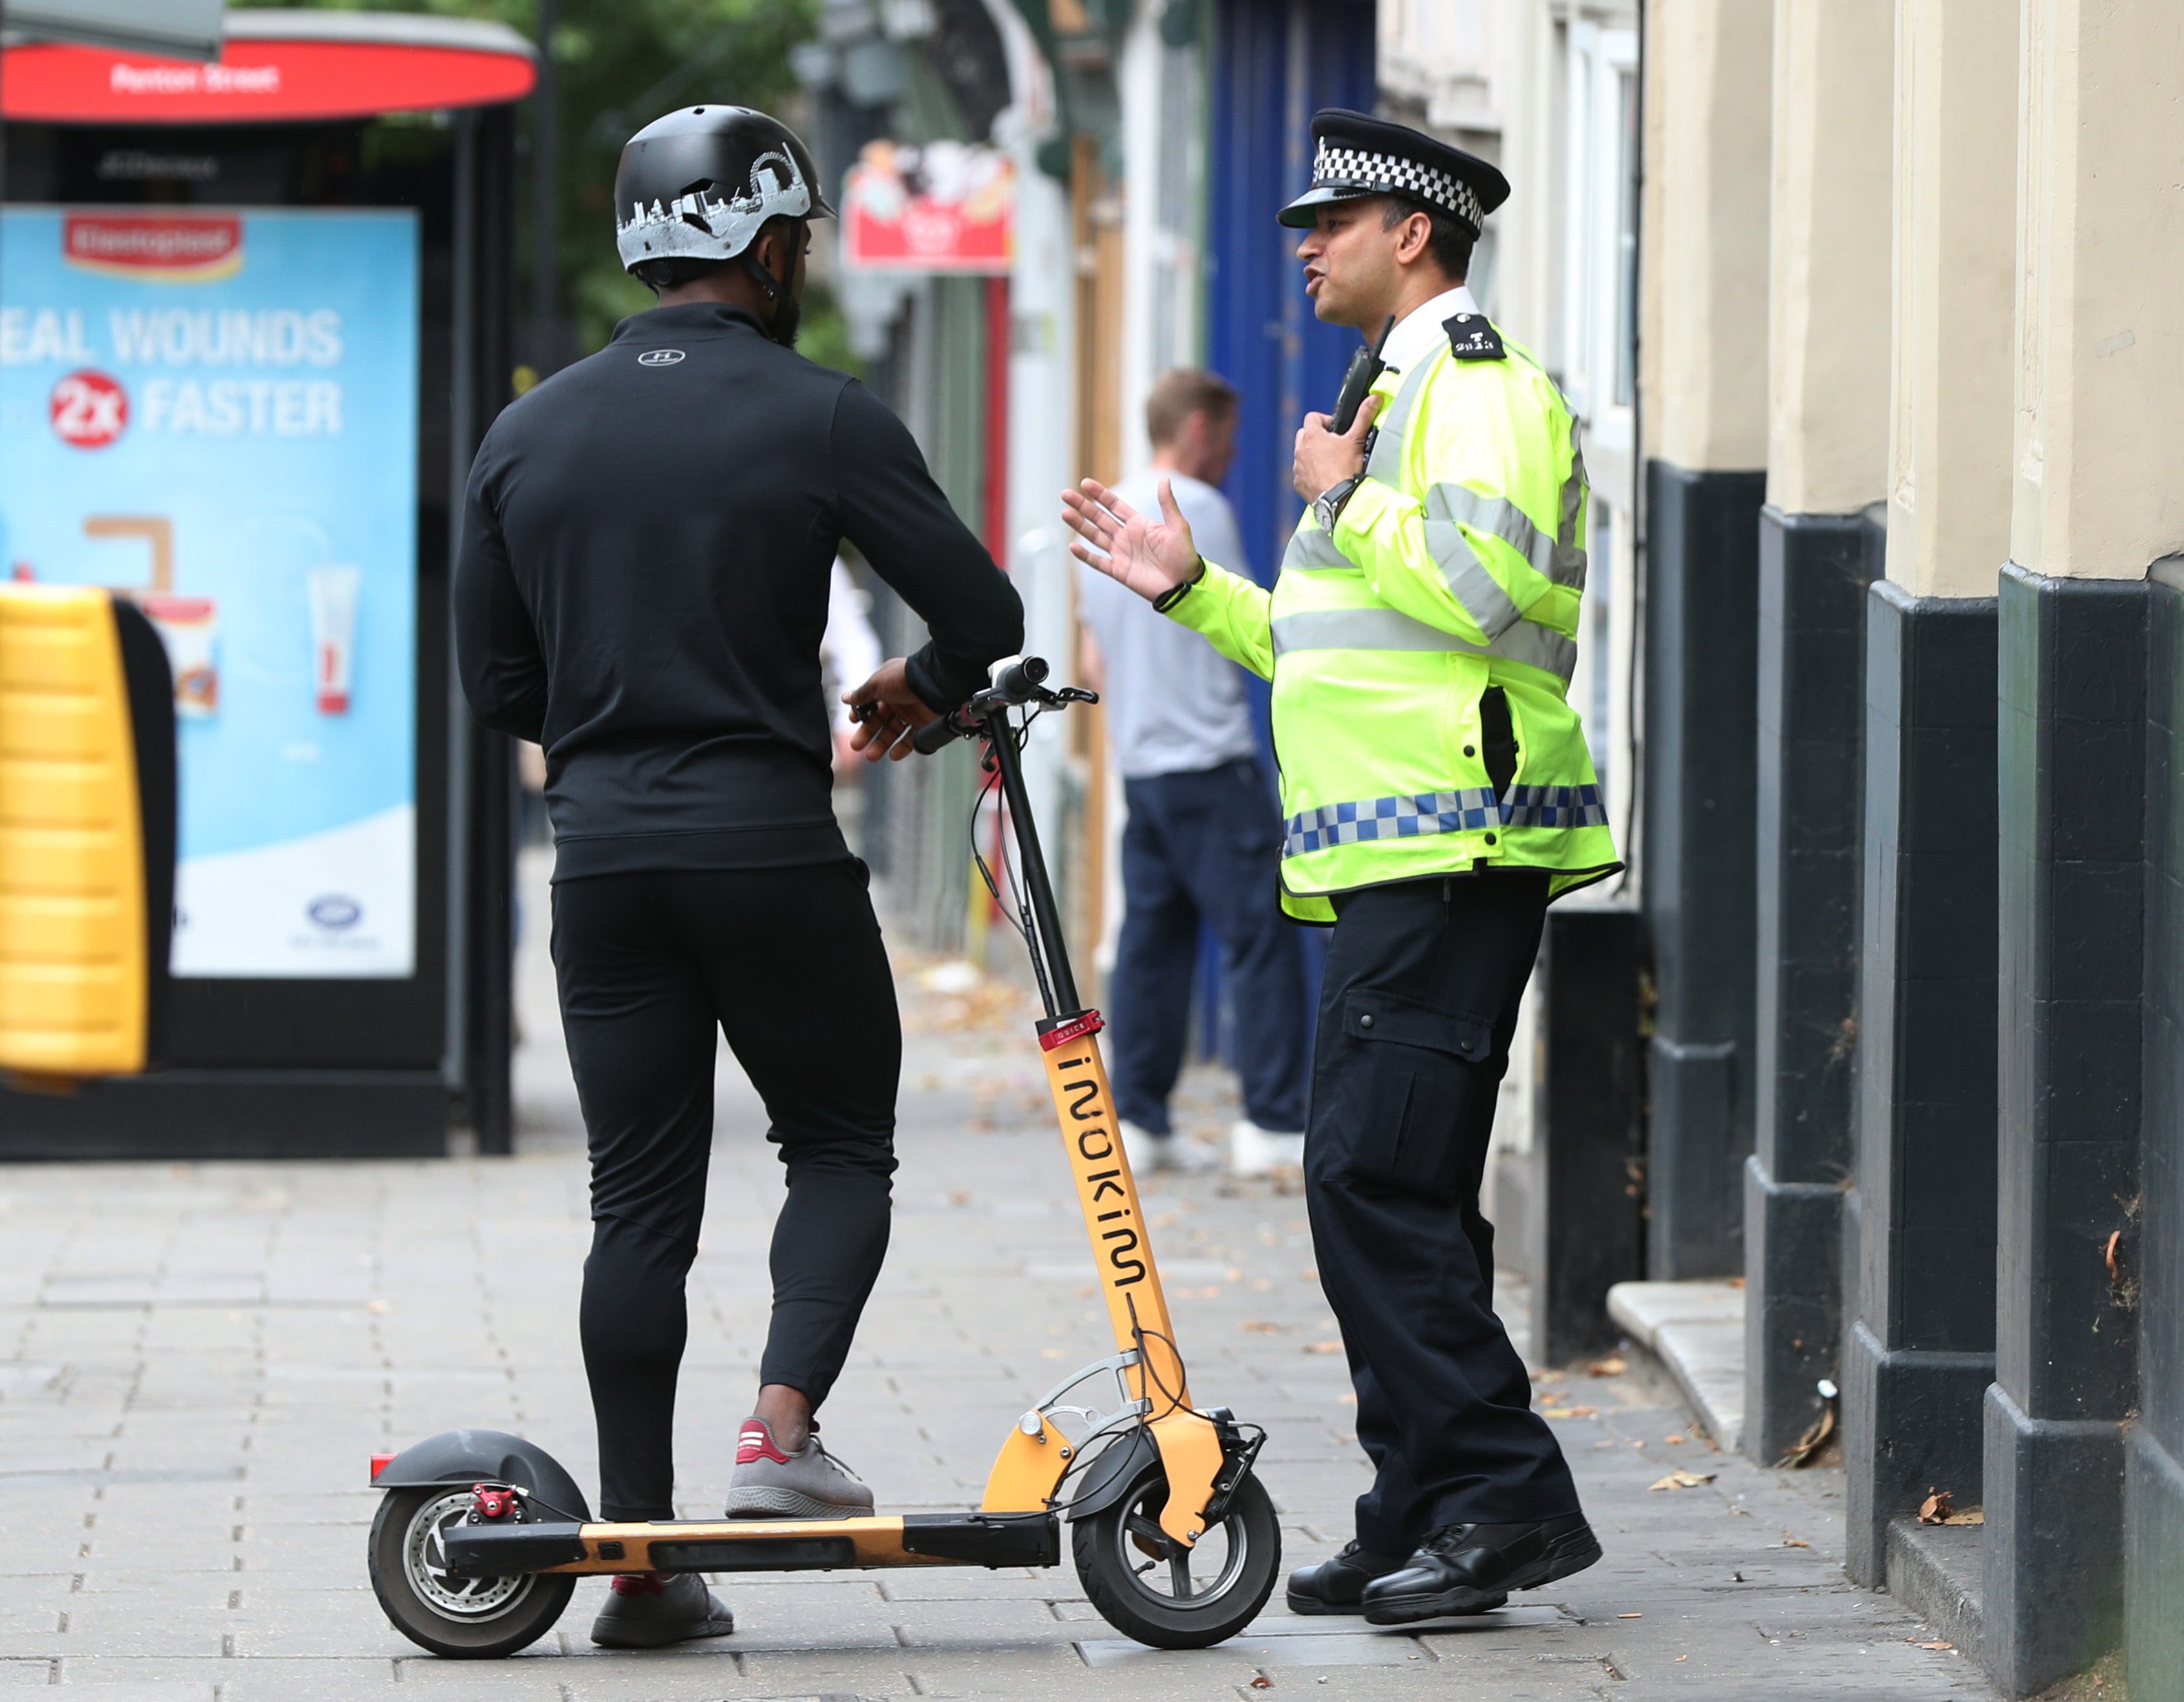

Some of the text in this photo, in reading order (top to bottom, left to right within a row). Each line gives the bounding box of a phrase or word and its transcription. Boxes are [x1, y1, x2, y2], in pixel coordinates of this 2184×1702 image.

[204, 63, 280, 94] Street
[109, 308, 344, 366] WOUNDS
[52, 376, 124, 436] 2x
[143, 380, 343, 436] FASTER
[1057, 1023, 1085, 1039] QUICK
